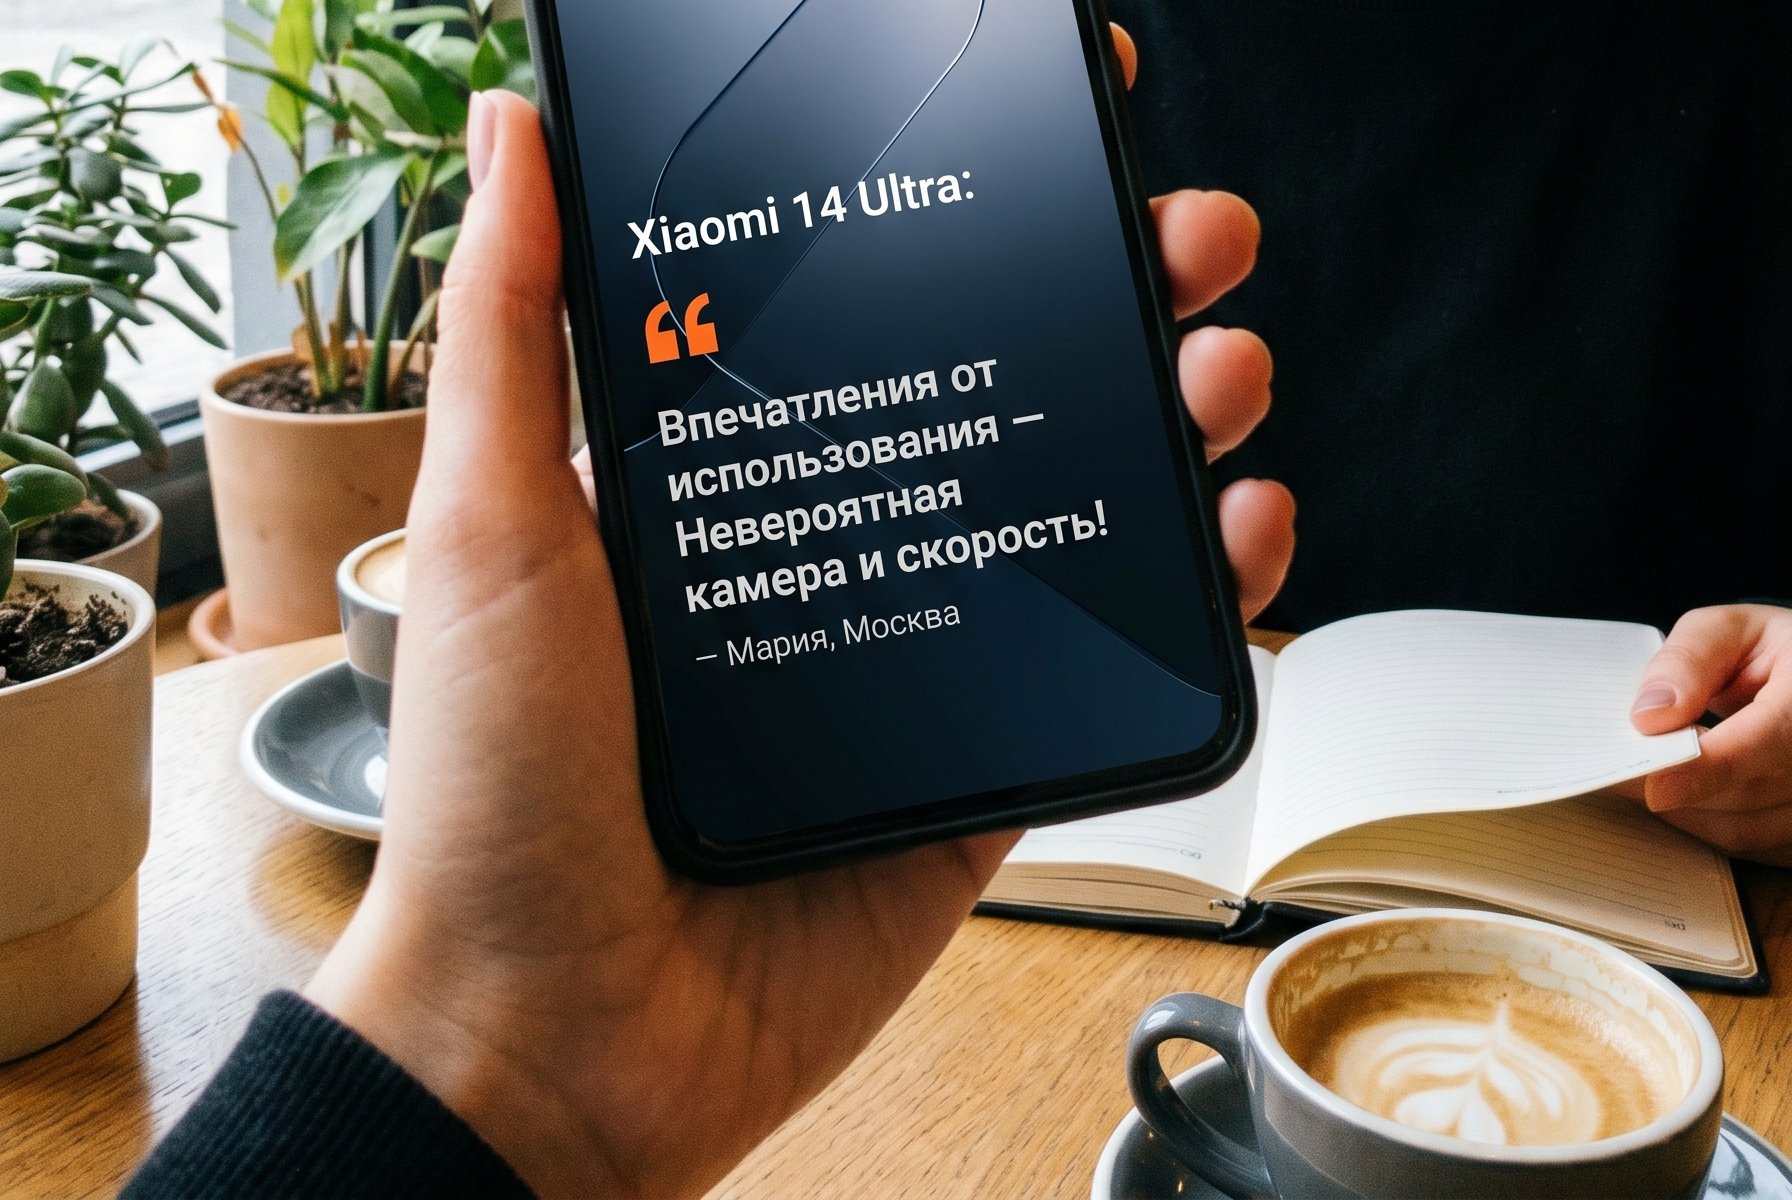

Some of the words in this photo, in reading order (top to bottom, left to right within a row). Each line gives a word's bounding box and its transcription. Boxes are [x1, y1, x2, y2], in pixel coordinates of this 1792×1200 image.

[627, 195, 780, 260] Xiaomi
[792, 185, 848, 229] 14
[857, 170, 976, 218] Ultra:
[656, 369, 940, 448] Впечатления
[950, 358, 998, 394] от
[666, 414, 1000, 502] использования
[674, 478, 964, 558] Невероятная
[684, 557, 848, 613] камера
[858, 550, 886, 581] и
[896, 499, 1109, 574] скорость!
[726, 627, 837, 666] Мария,
[842, 603, 962, 646] Москва
